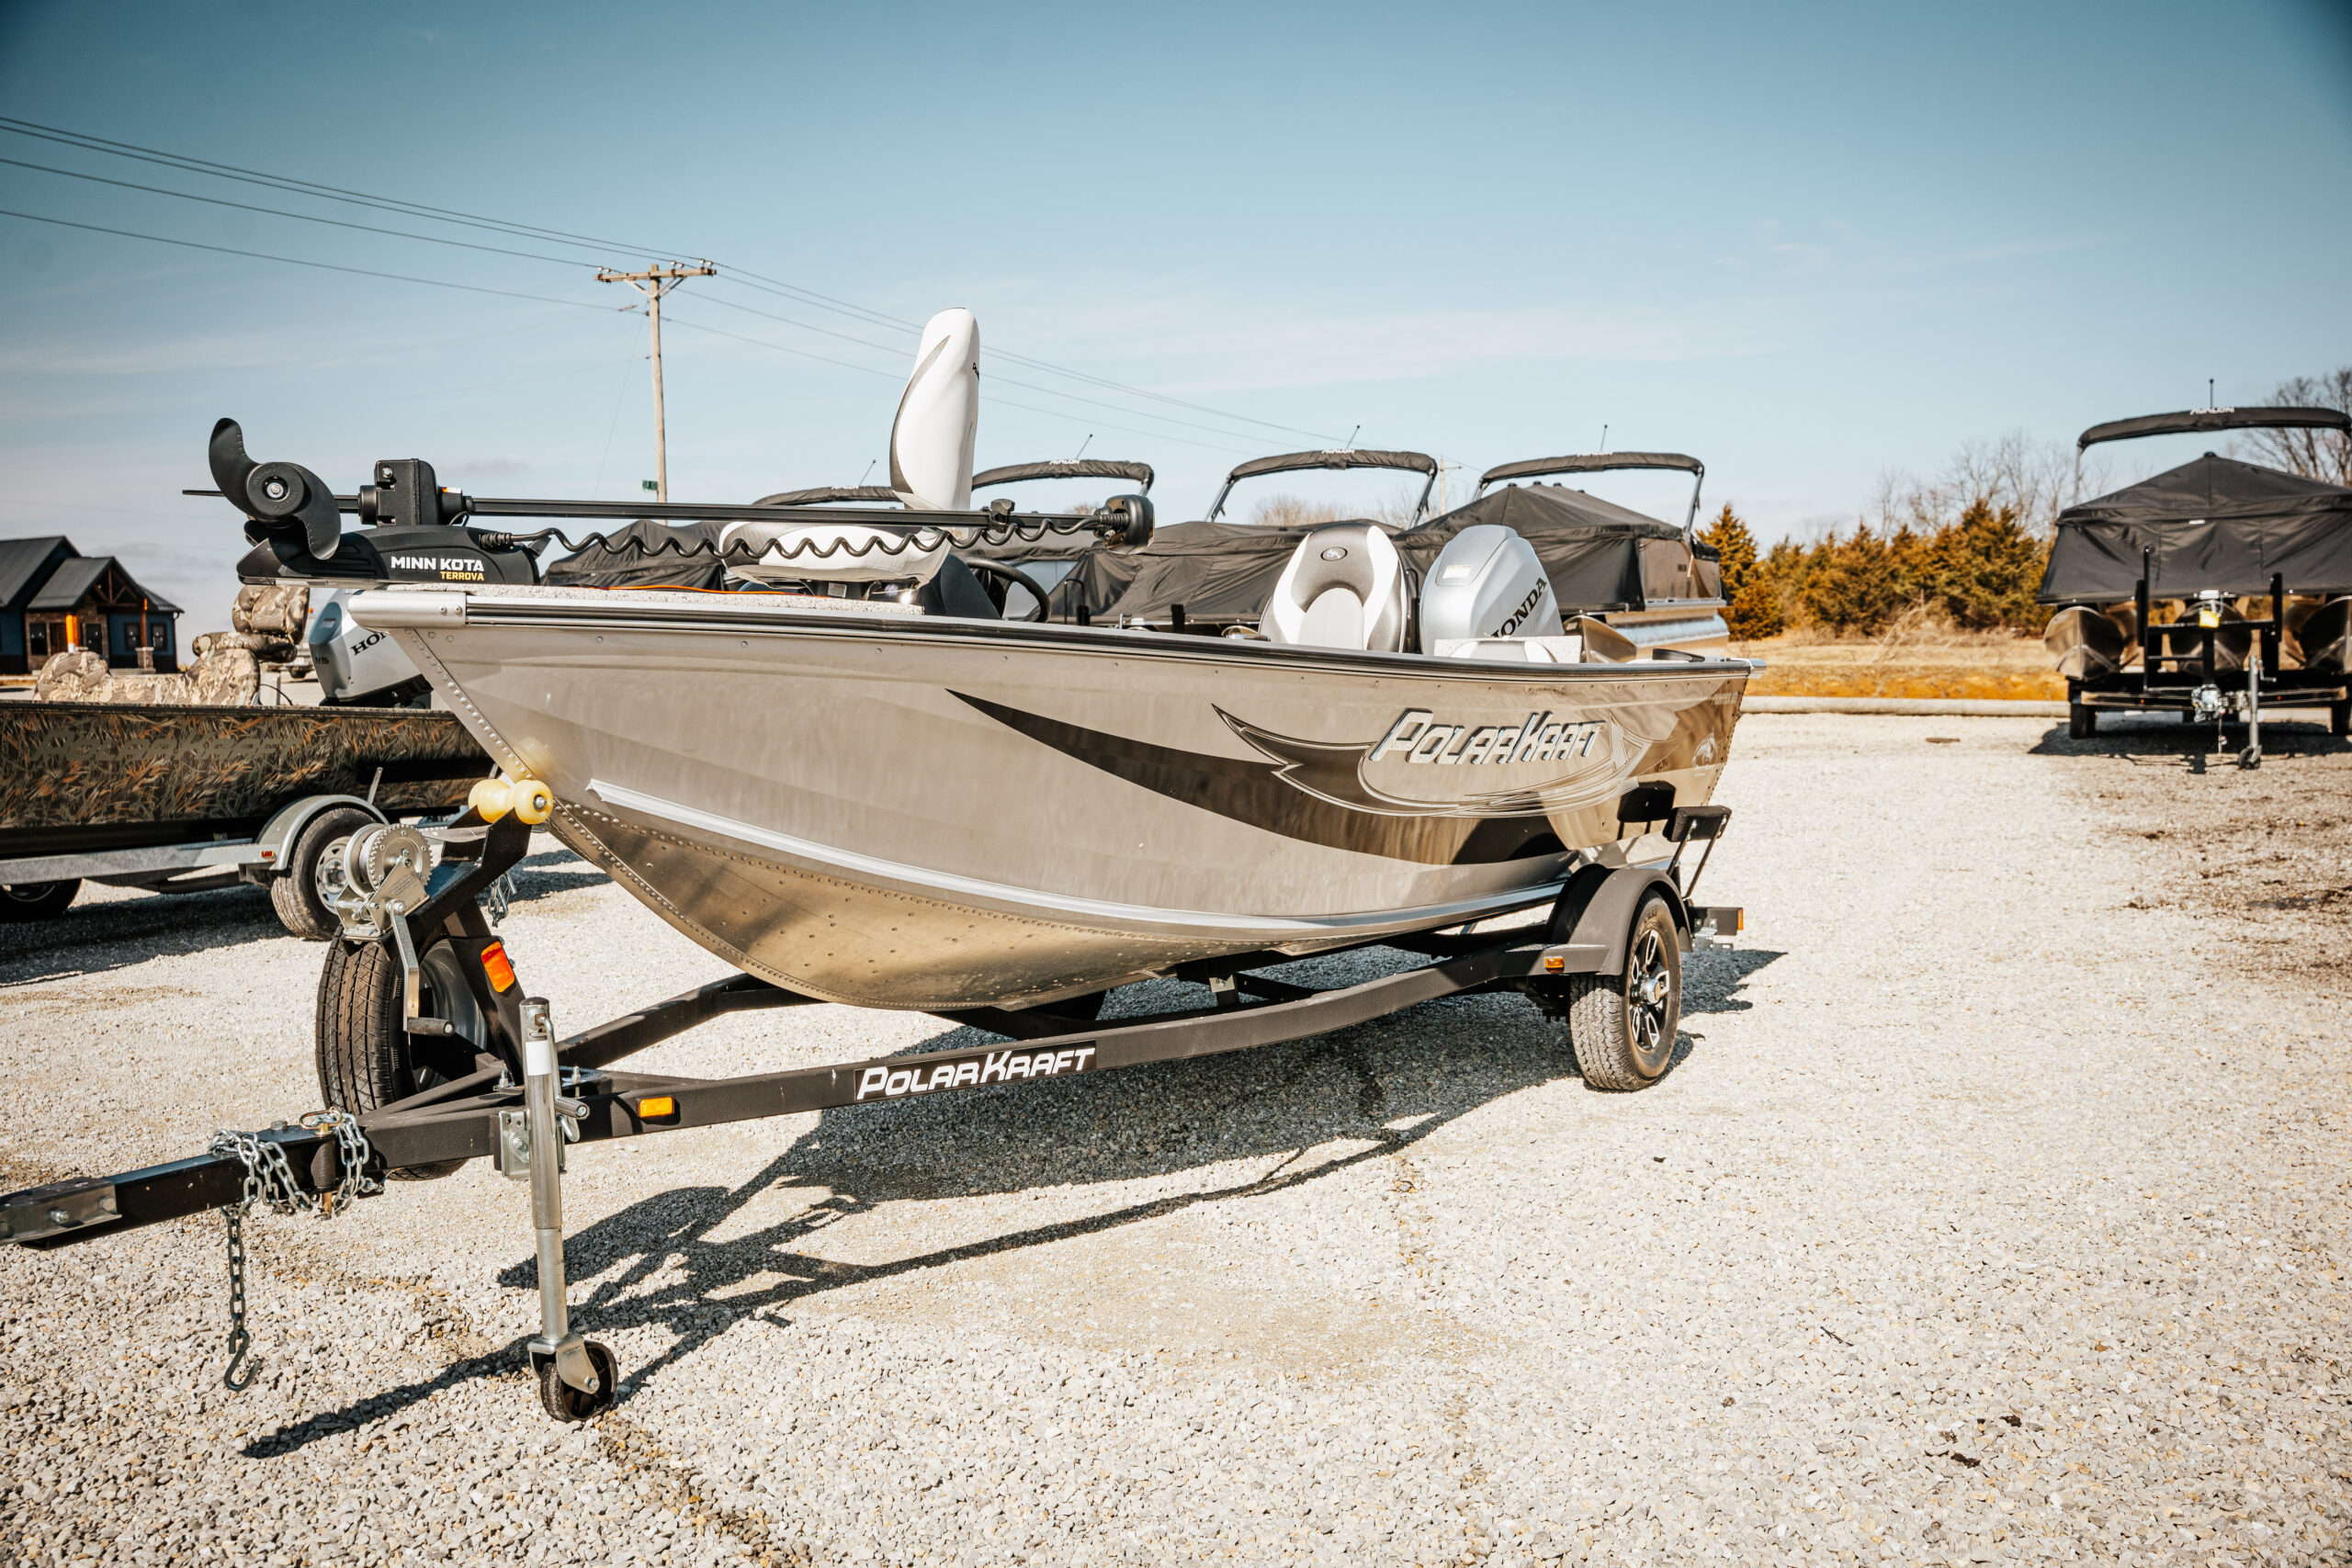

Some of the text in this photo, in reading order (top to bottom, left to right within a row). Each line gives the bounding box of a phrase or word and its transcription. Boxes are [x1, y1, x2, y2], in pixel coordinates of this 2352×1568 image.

[390, 556, 485, 572] MINN KOTA
[440, 570, 485, 581] TERROVA
[1369, 706, 1607, 765] POLARKRAFT
[856, 1047, 1096, 1100] POLARKRAFT
